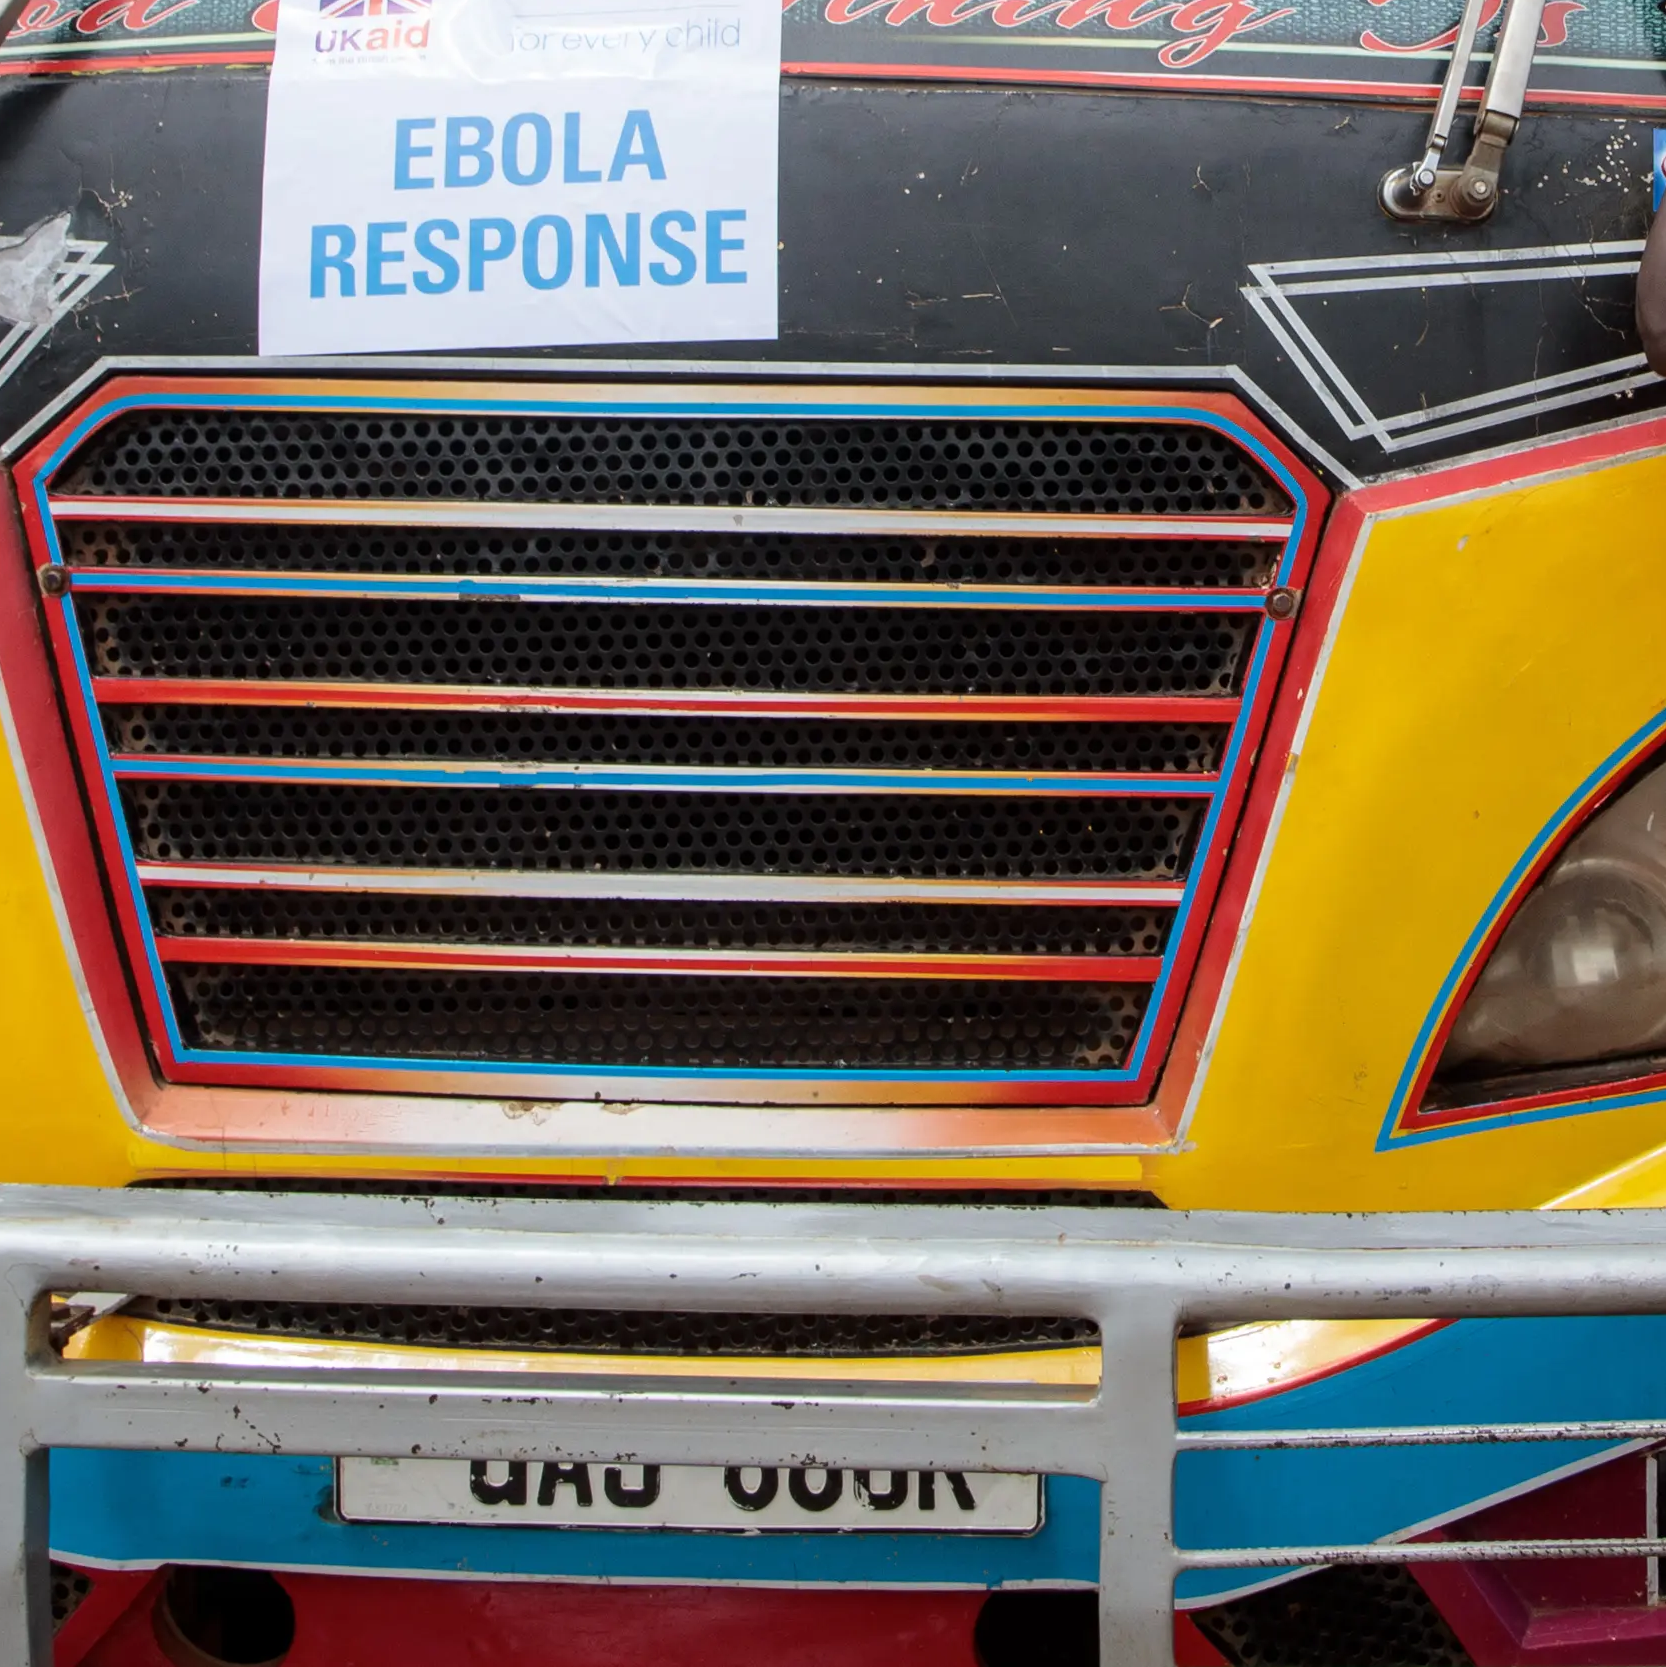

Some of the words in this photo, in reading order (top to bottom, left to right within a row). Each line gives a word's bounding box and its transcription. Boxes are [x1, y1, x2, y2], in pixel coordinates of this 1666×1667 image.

[314, 19, 431, 54] UKaid
[665, 18, 741, 48] child
[393, 109, 668, 191] EBOLA
[309, 209, 749, 300] RESPONSE
